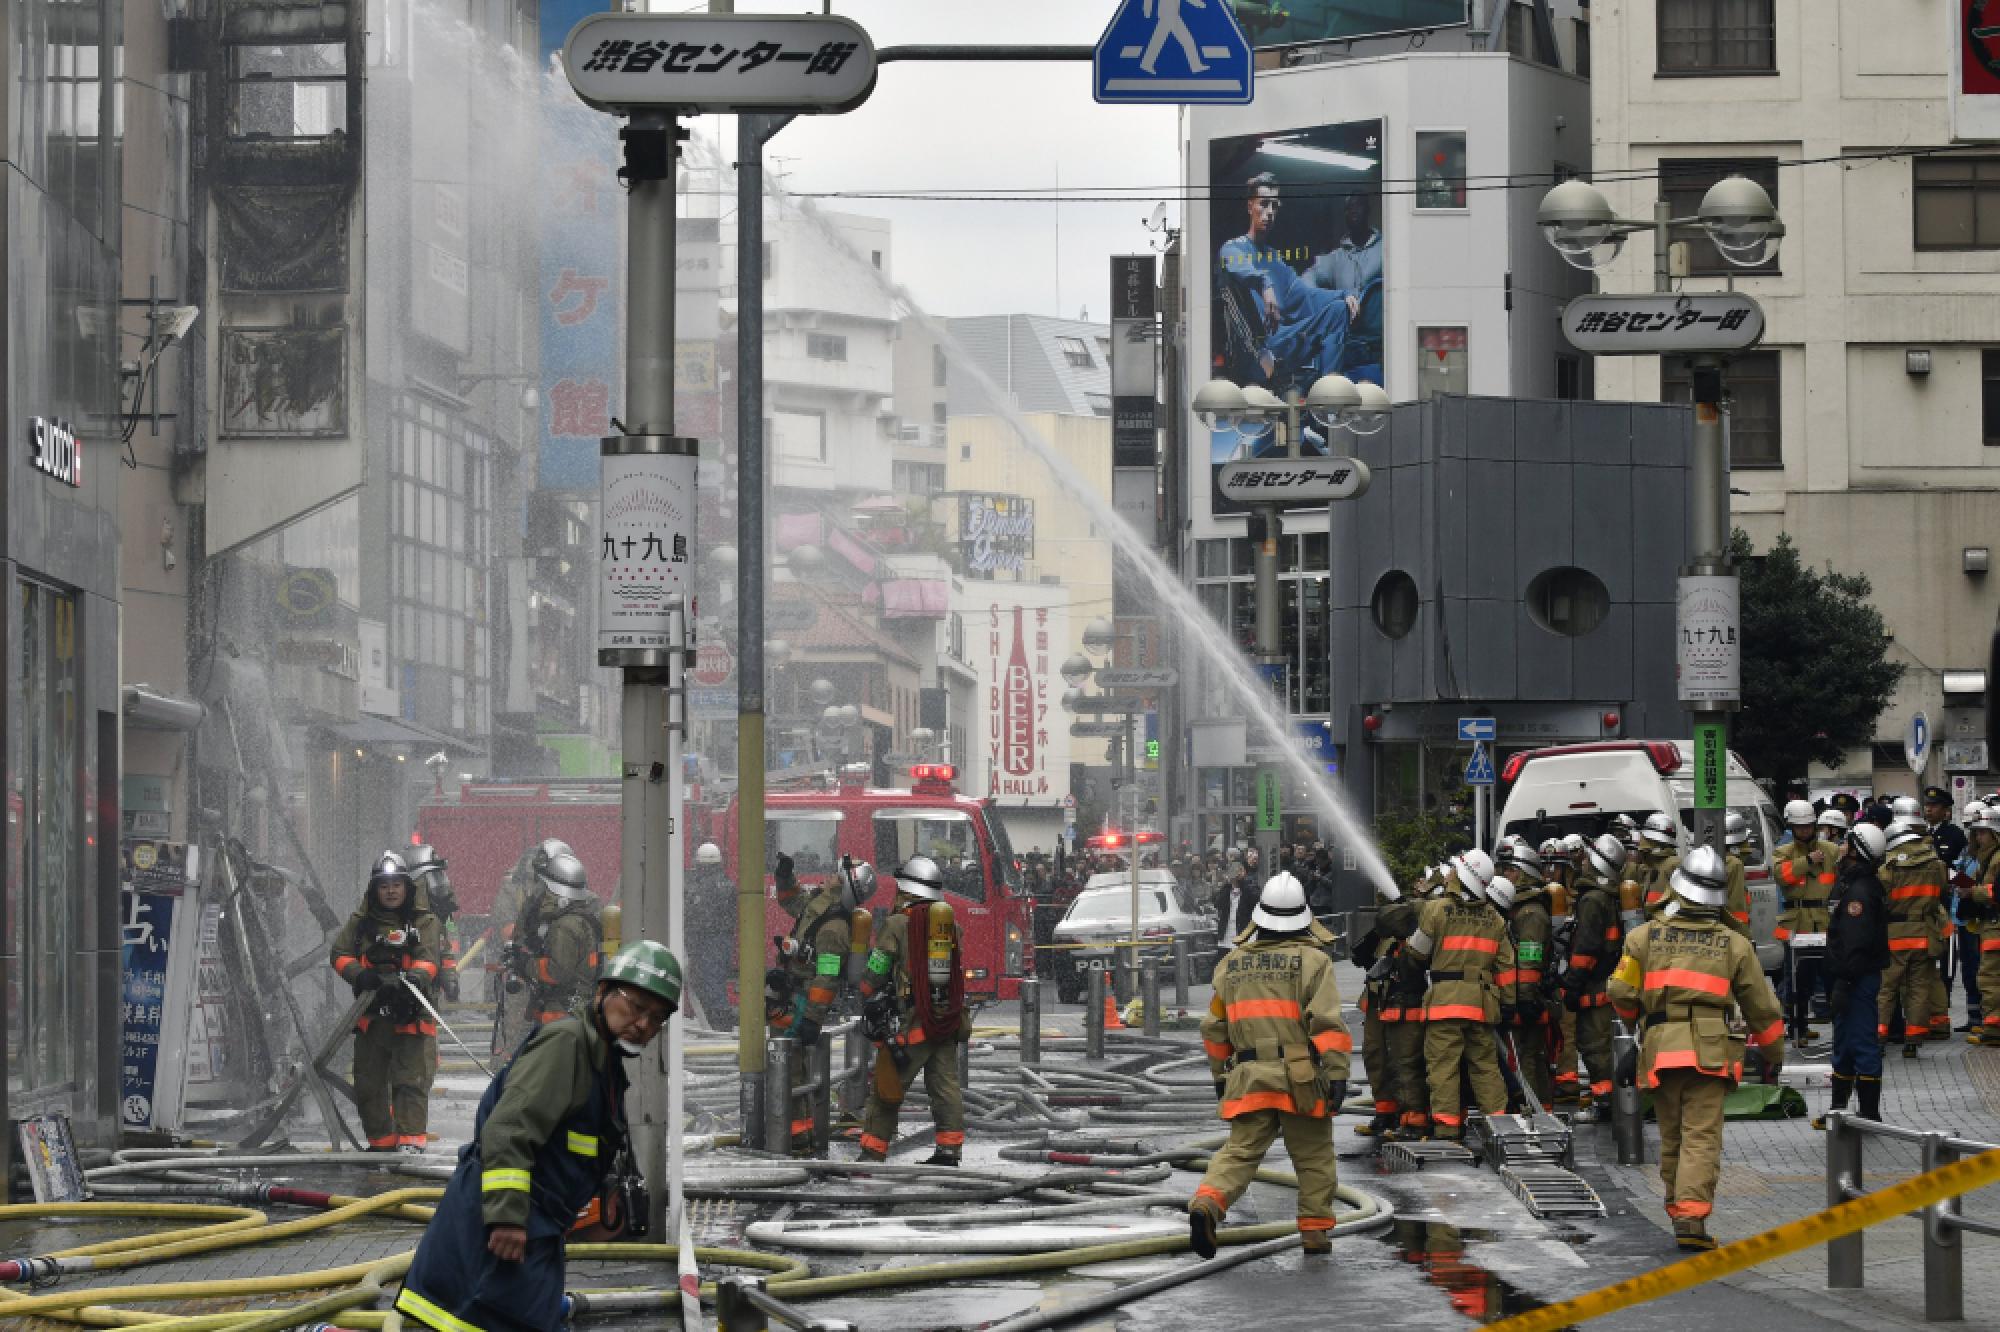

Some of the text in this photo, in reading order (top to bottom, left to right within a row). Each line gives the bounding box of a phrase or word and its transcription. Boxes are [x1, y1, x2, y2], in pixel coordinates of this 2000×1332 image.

[582, 40, 858, 74] 渋谷センター街
[1575, 308, 1750, 332] 渋谷センター街
[1227, 468, 1351, 488] 渋谷センター街
[602, 532, 688, 563] 九十九島
[1682, 626, 1737, 645] 九十九島
[990, 604, 1000, 794] SHIBUYA
[1036, 608, 1048, 794] 宇田川ビアホール
[1009, 666, 1029, 771] BEER
[1004, 780, 1034, 795] HALL
[1650, 928, 1730, 948] 東京消防庁
[1076, 959, 1116, 972] POL
[1226, 954, 1302, 975] 東京消防庁
